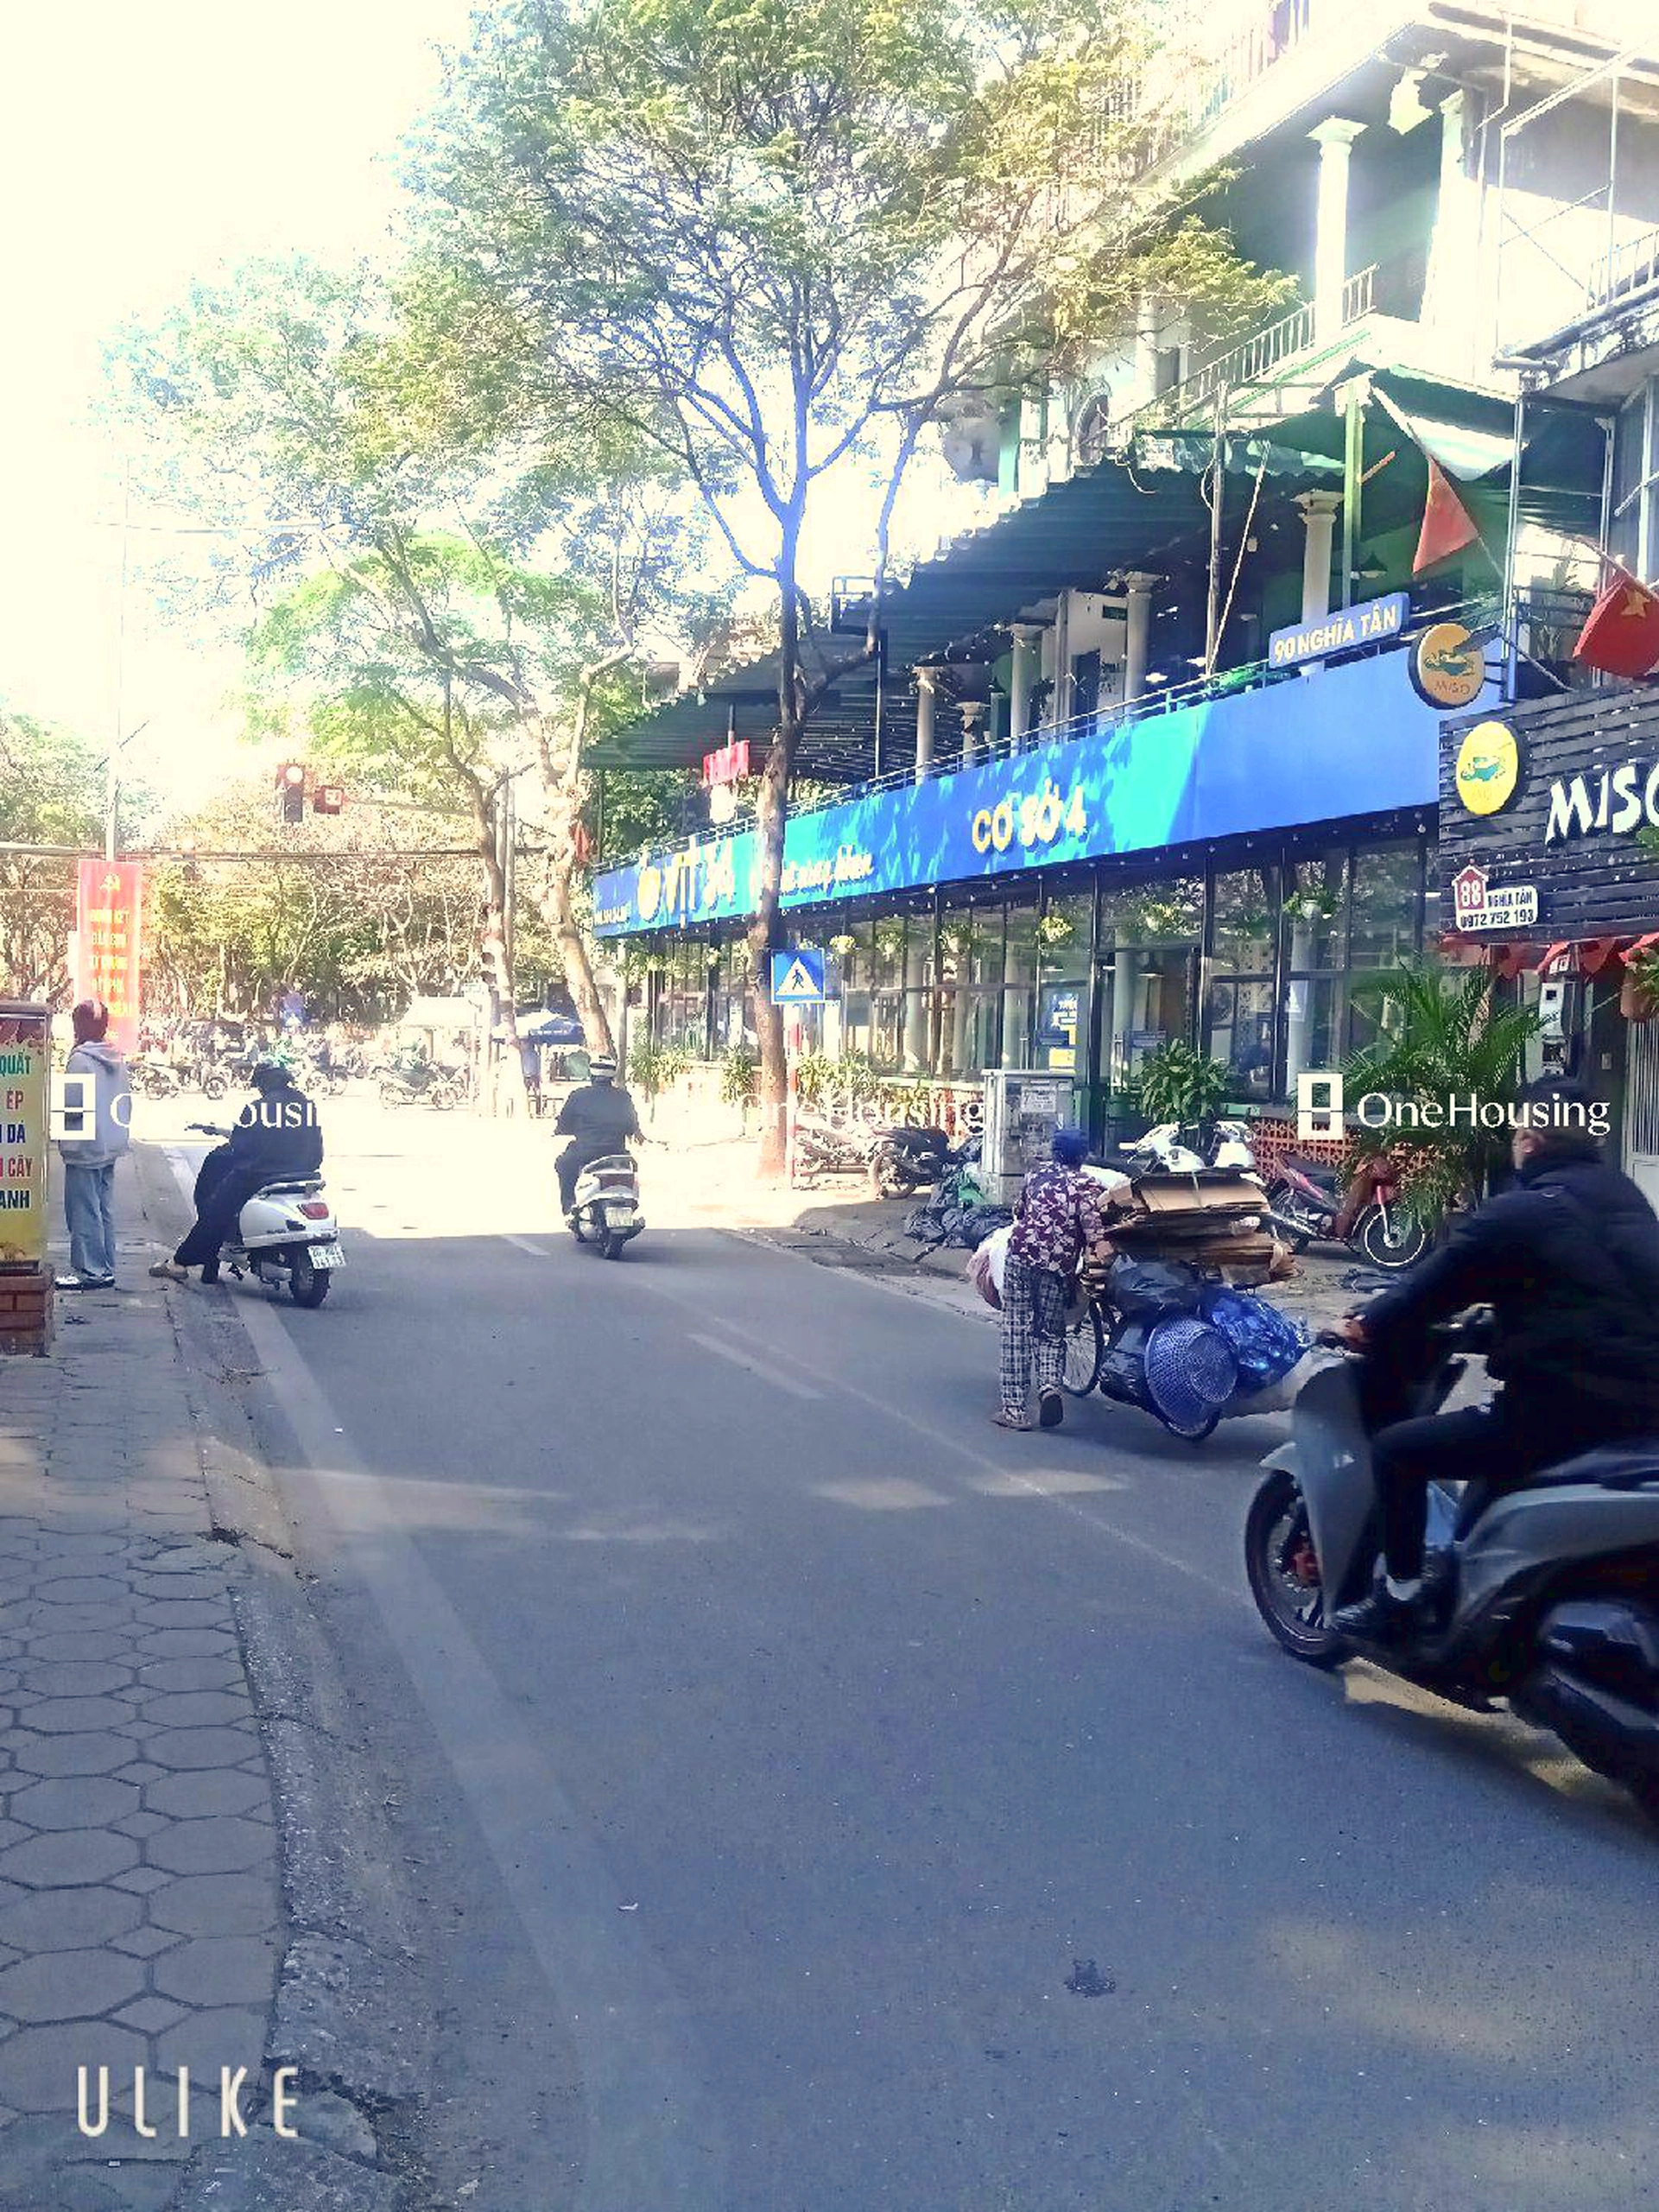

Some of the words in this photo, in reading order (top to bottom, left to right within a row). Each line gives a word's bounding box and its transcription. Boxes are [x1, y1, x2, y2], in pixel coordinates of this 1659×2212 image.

[1275, 637, 1295, 664] 90
[1297, 618, 1355, 655] NGHĨA
[1360, 603, 1396, 637] TÂN
[1460, 879, 1482, 907] 88
[1487, 891, 1514, 909] NGHĨA
[1515, 888, 1533, 906] TÂN
[1460, 914, 1487, 929] 0972
[1490, 910, 1510, 925] 752
[1513, 909, 1535, 923] 193
[6, 1087, 24, 1110] ÉP
[8, 1156, 33, 1177] CÂY
